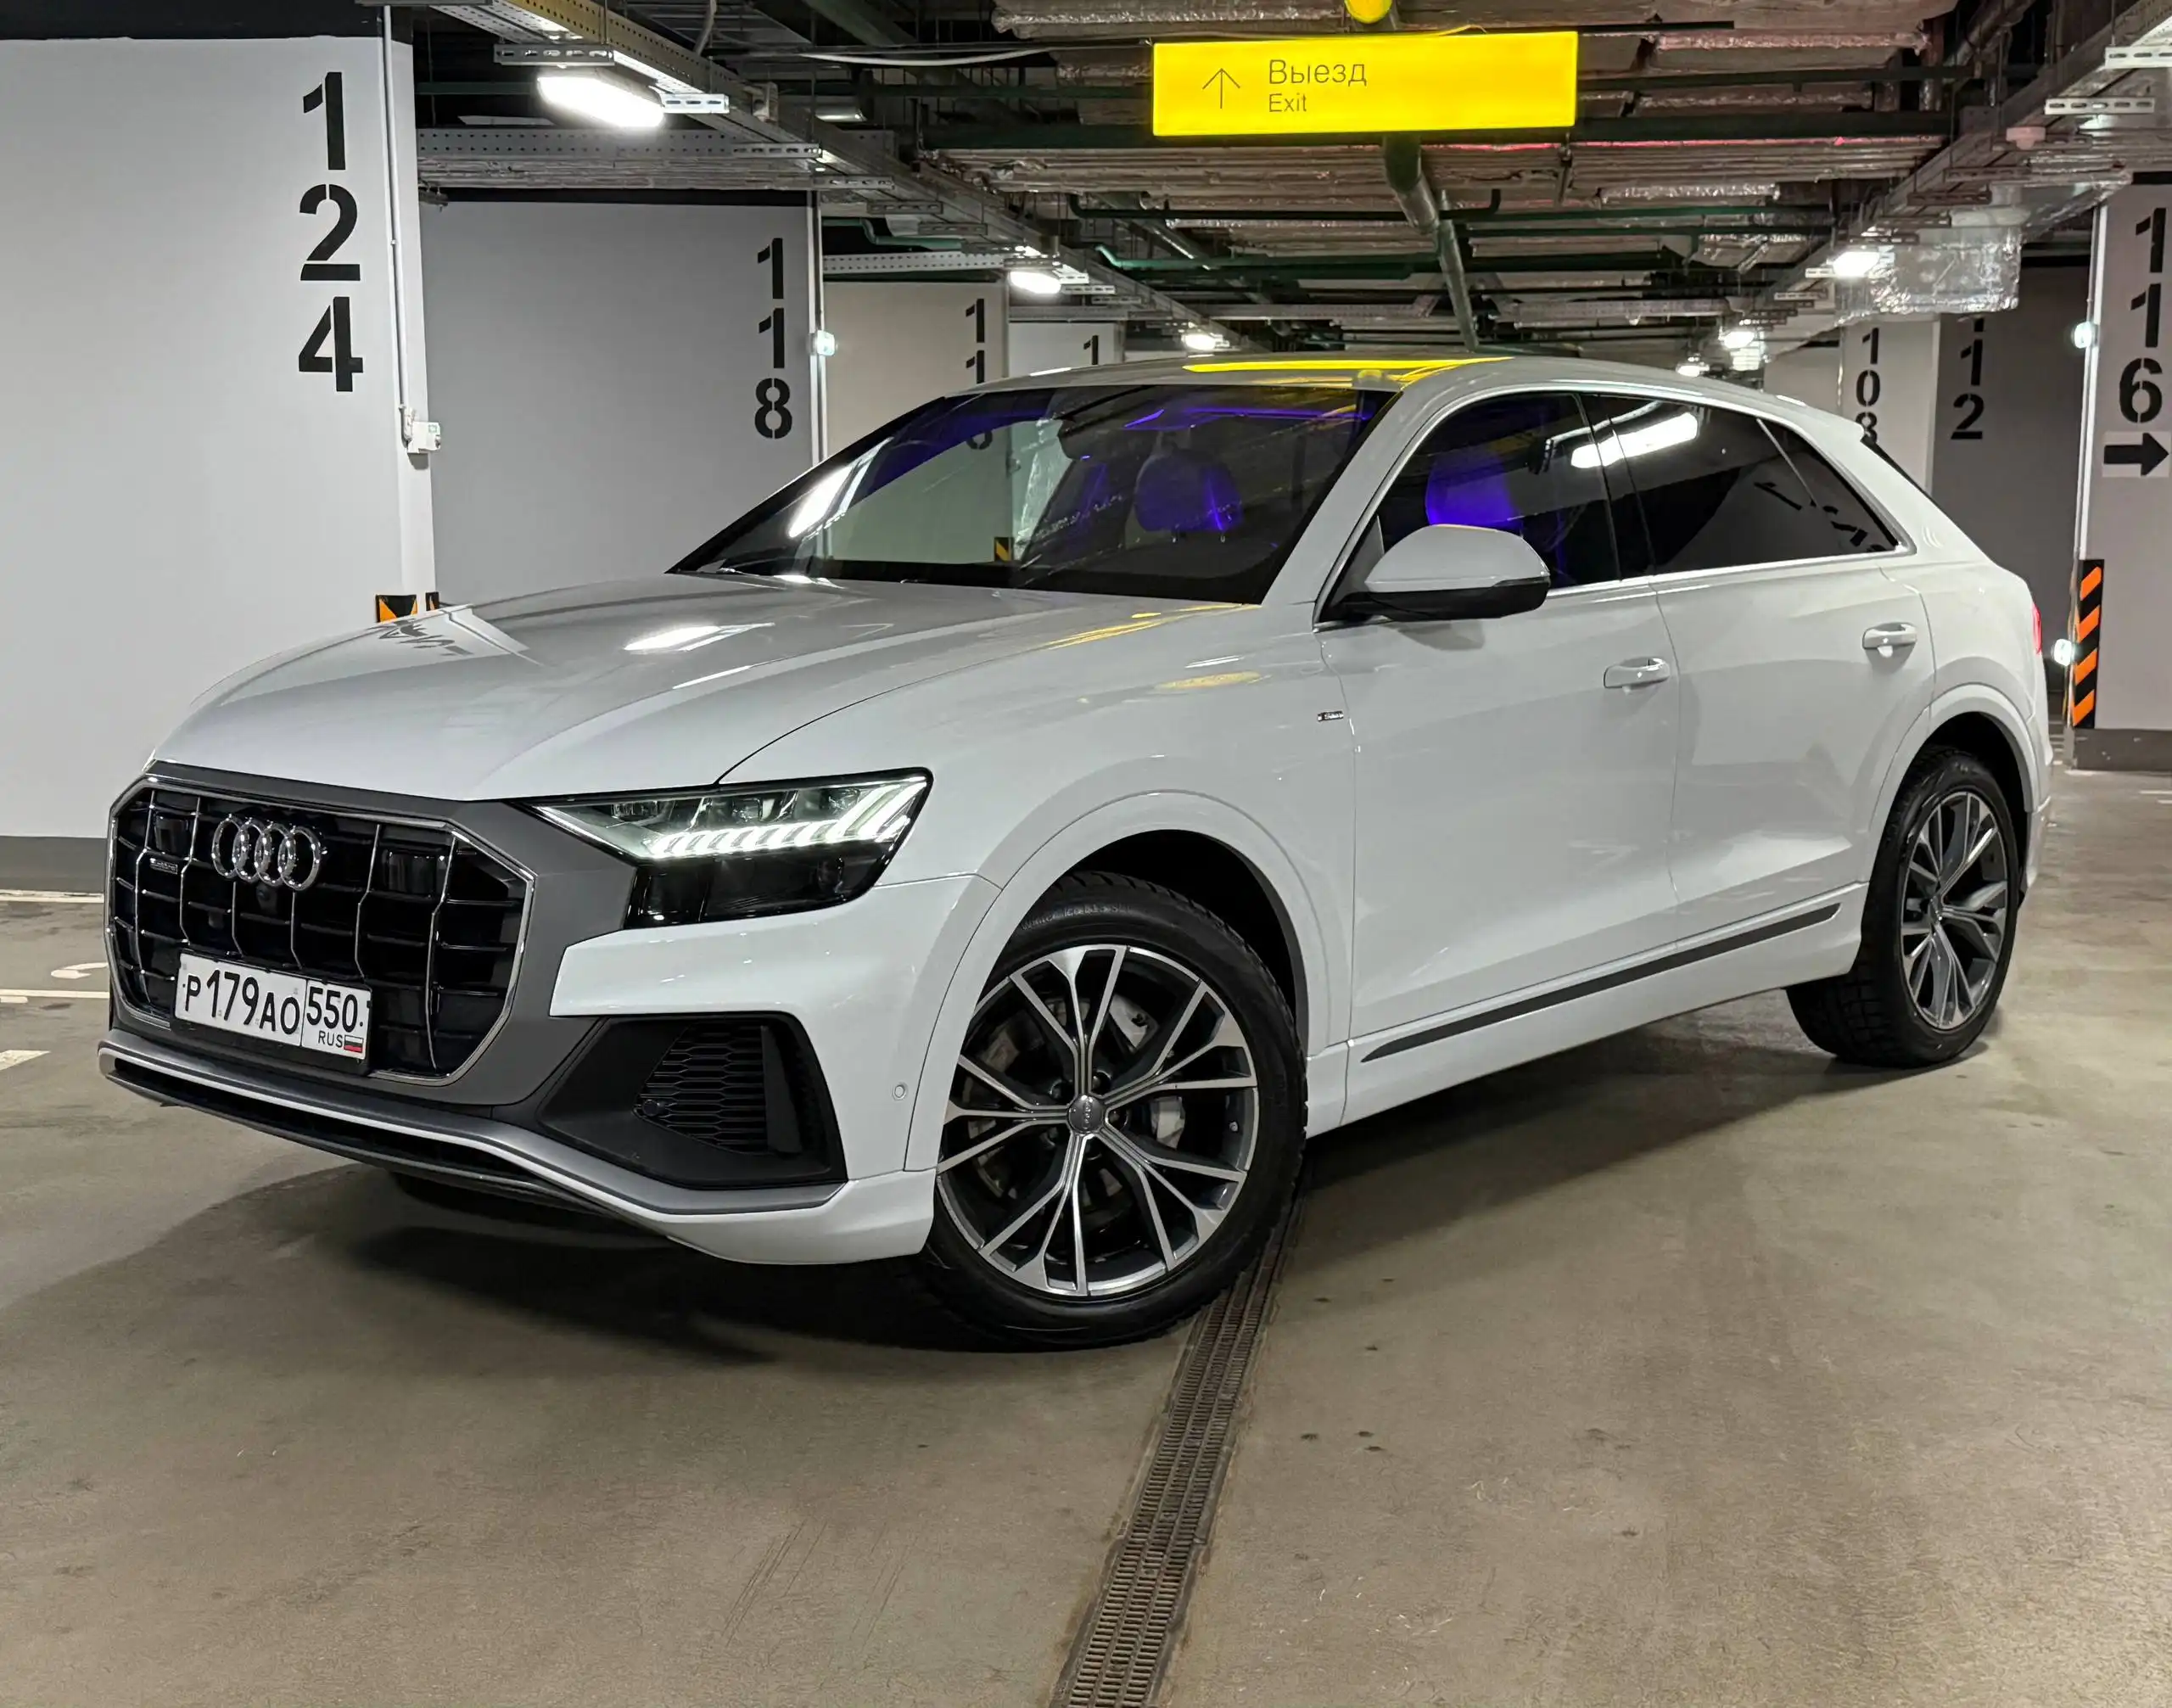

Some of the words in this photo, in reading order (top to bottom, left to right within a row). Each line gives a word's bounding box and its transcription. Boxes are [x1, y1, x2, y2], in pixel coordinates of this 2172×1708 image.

[1268, 59, 1368, 87] Выезд
[1268, 92, 1307, 112] Exit
[298, 71, 364, 392] 124
[754, 237, 792, 440] 118
[2119, 207, 2167, 423] 116
[306, 985, 358, 1033] 550
[317, 1030, 344, 1049] RUS
